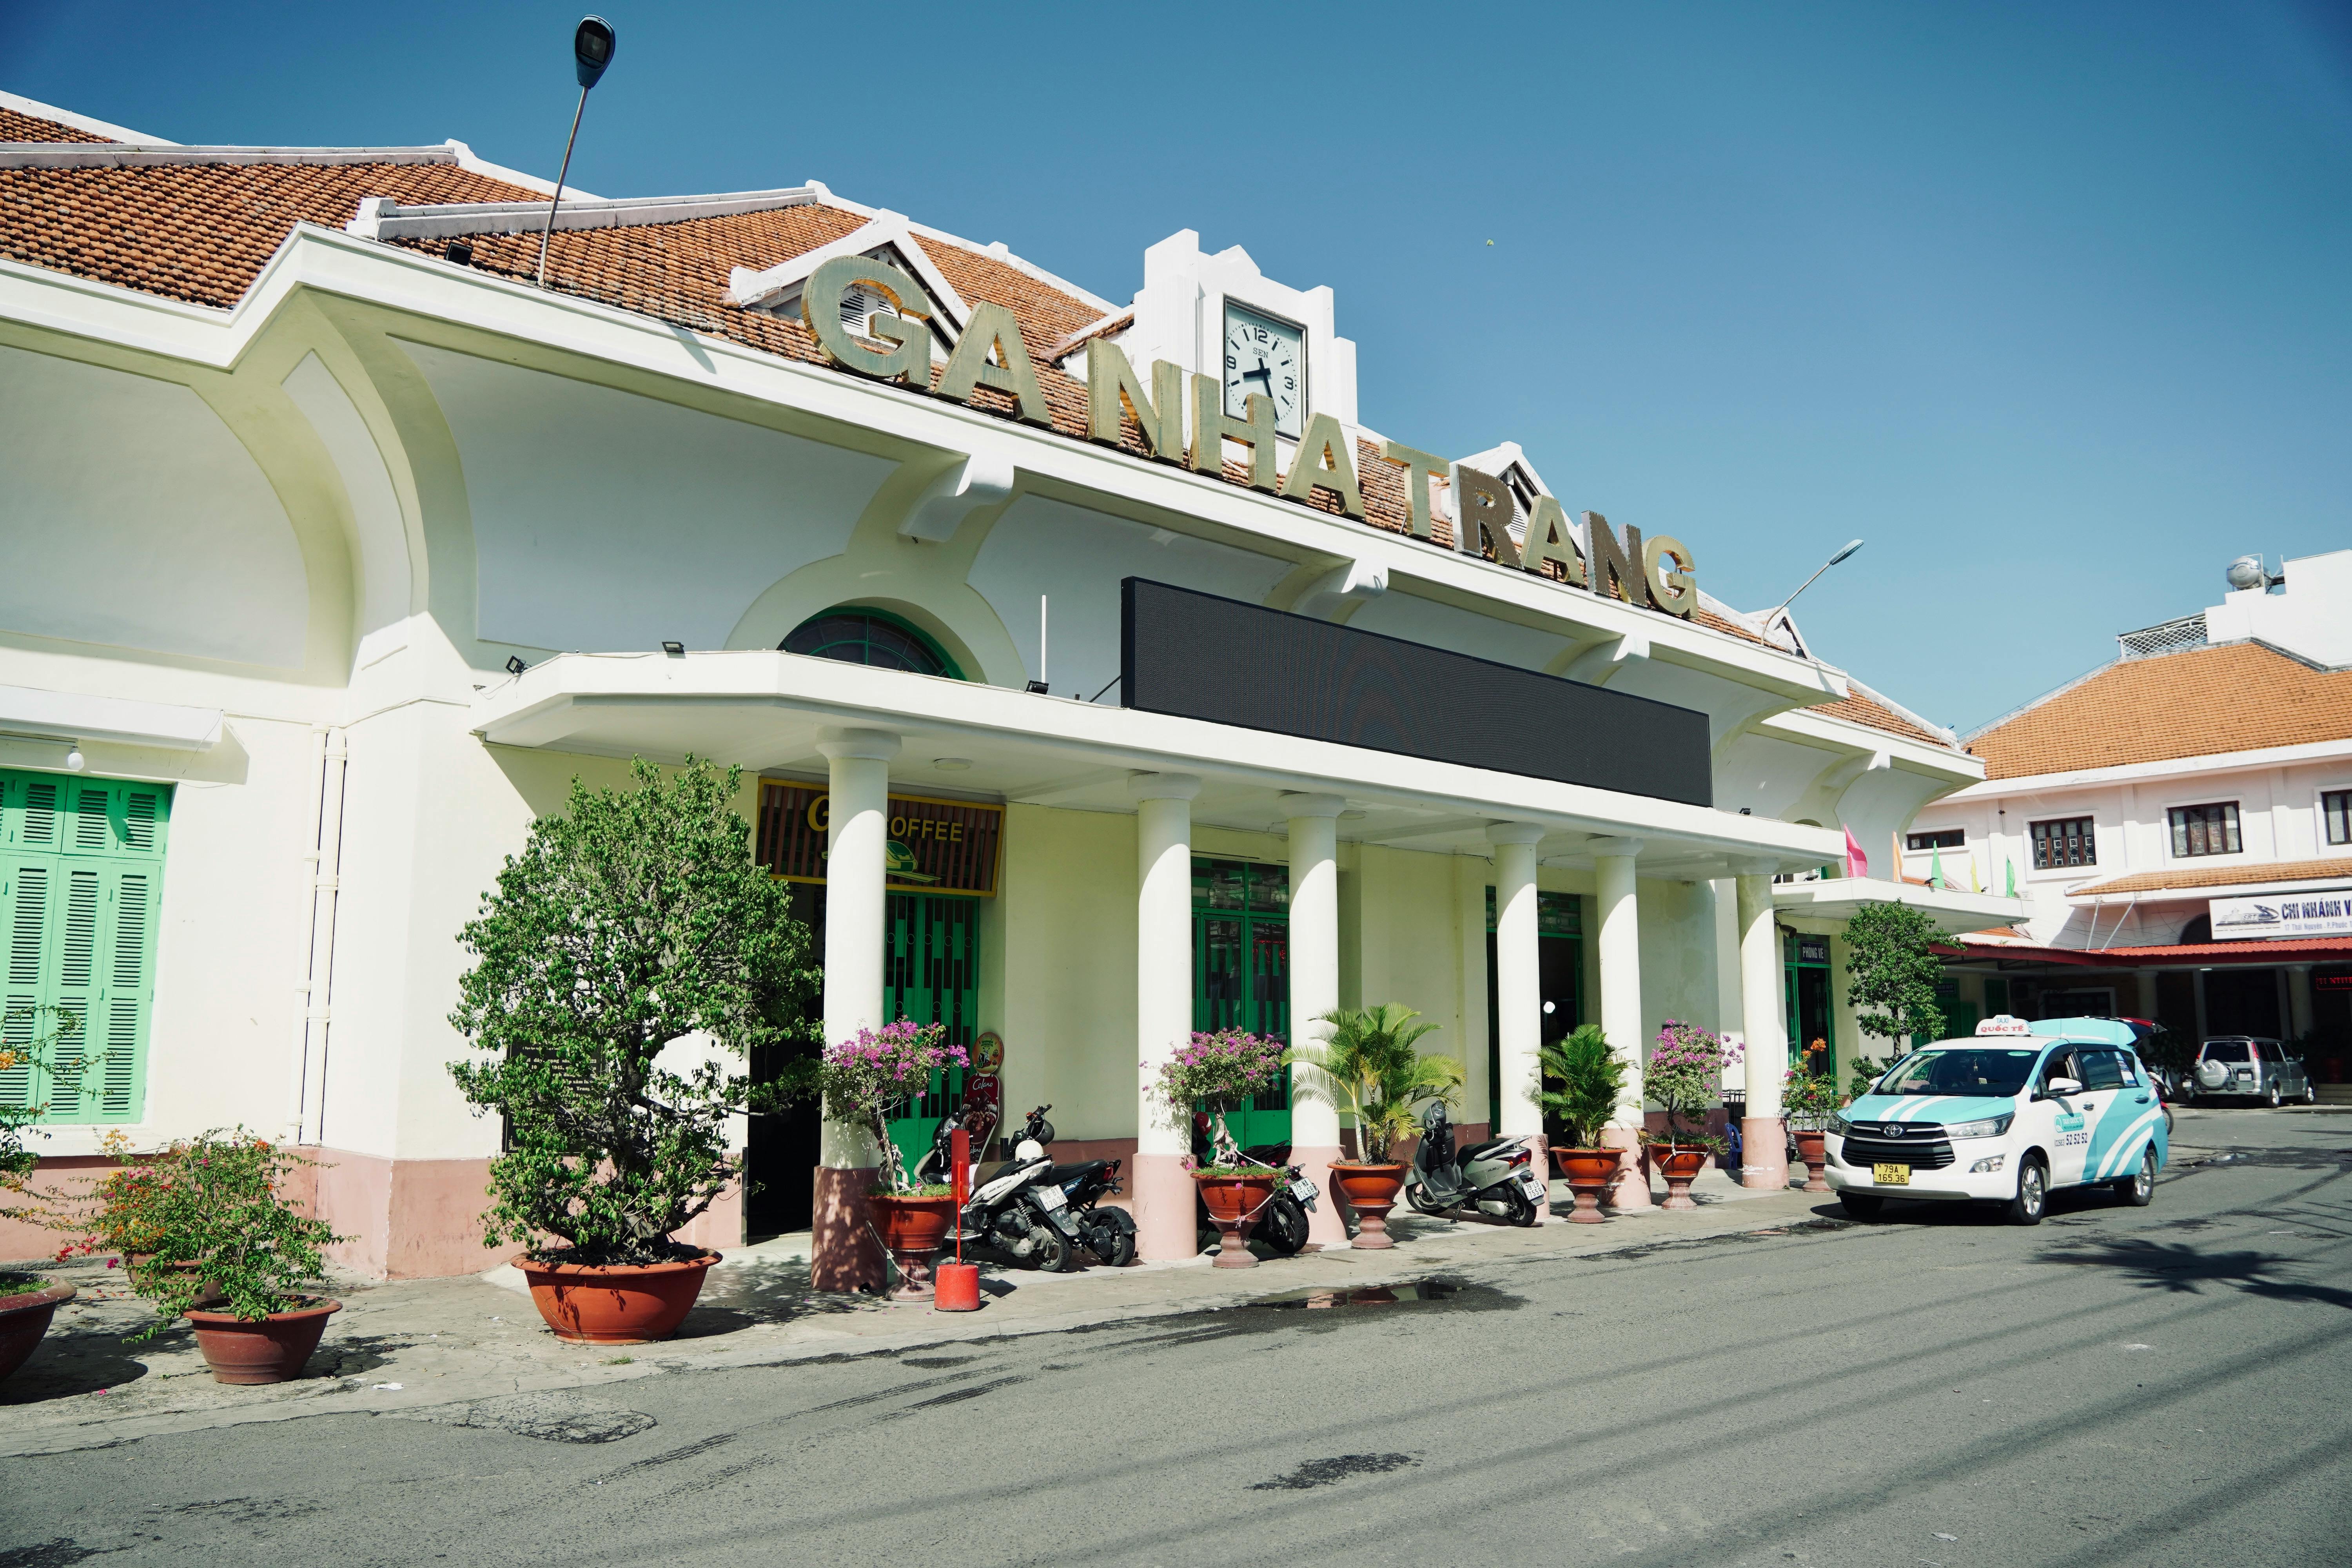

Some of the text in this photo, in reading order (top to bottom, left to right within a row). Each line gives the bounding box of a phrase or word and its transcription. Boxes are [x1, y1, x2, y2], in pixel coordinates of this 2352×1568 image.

[1254, 327, 1268, 344] 12
[1253, 347, 1269, 358] SEN
[1226, 355, 1236, 370] 9
[1284, 376, 1294, 390] 3
[801, 255, 1699, 619] GA NHA TRANG
[887, 816, 963, 842] OFFEE
[2282, 903, 2299, 920] CHI
[2302, 898, 2341, 918] NHÁNH
[1803, 944, 1818, 958] PHÒNG
[1981, 1024, 2008, 1033] QUỐC
[973, 1078, 993, 1090] Celano
[2066, 1134, 2073, 1145] 52
[2074, 1133, 2080, 1144] 52
[2082, 1132, 2087, 1143] 52
[969, 1145, 981, 1154] elano
[1884, 1165, 1898, 1173] 79A
[1879, 1174, 1905, 1182] 165.36
[1045, 1194, 1066, 1210] 720.38
